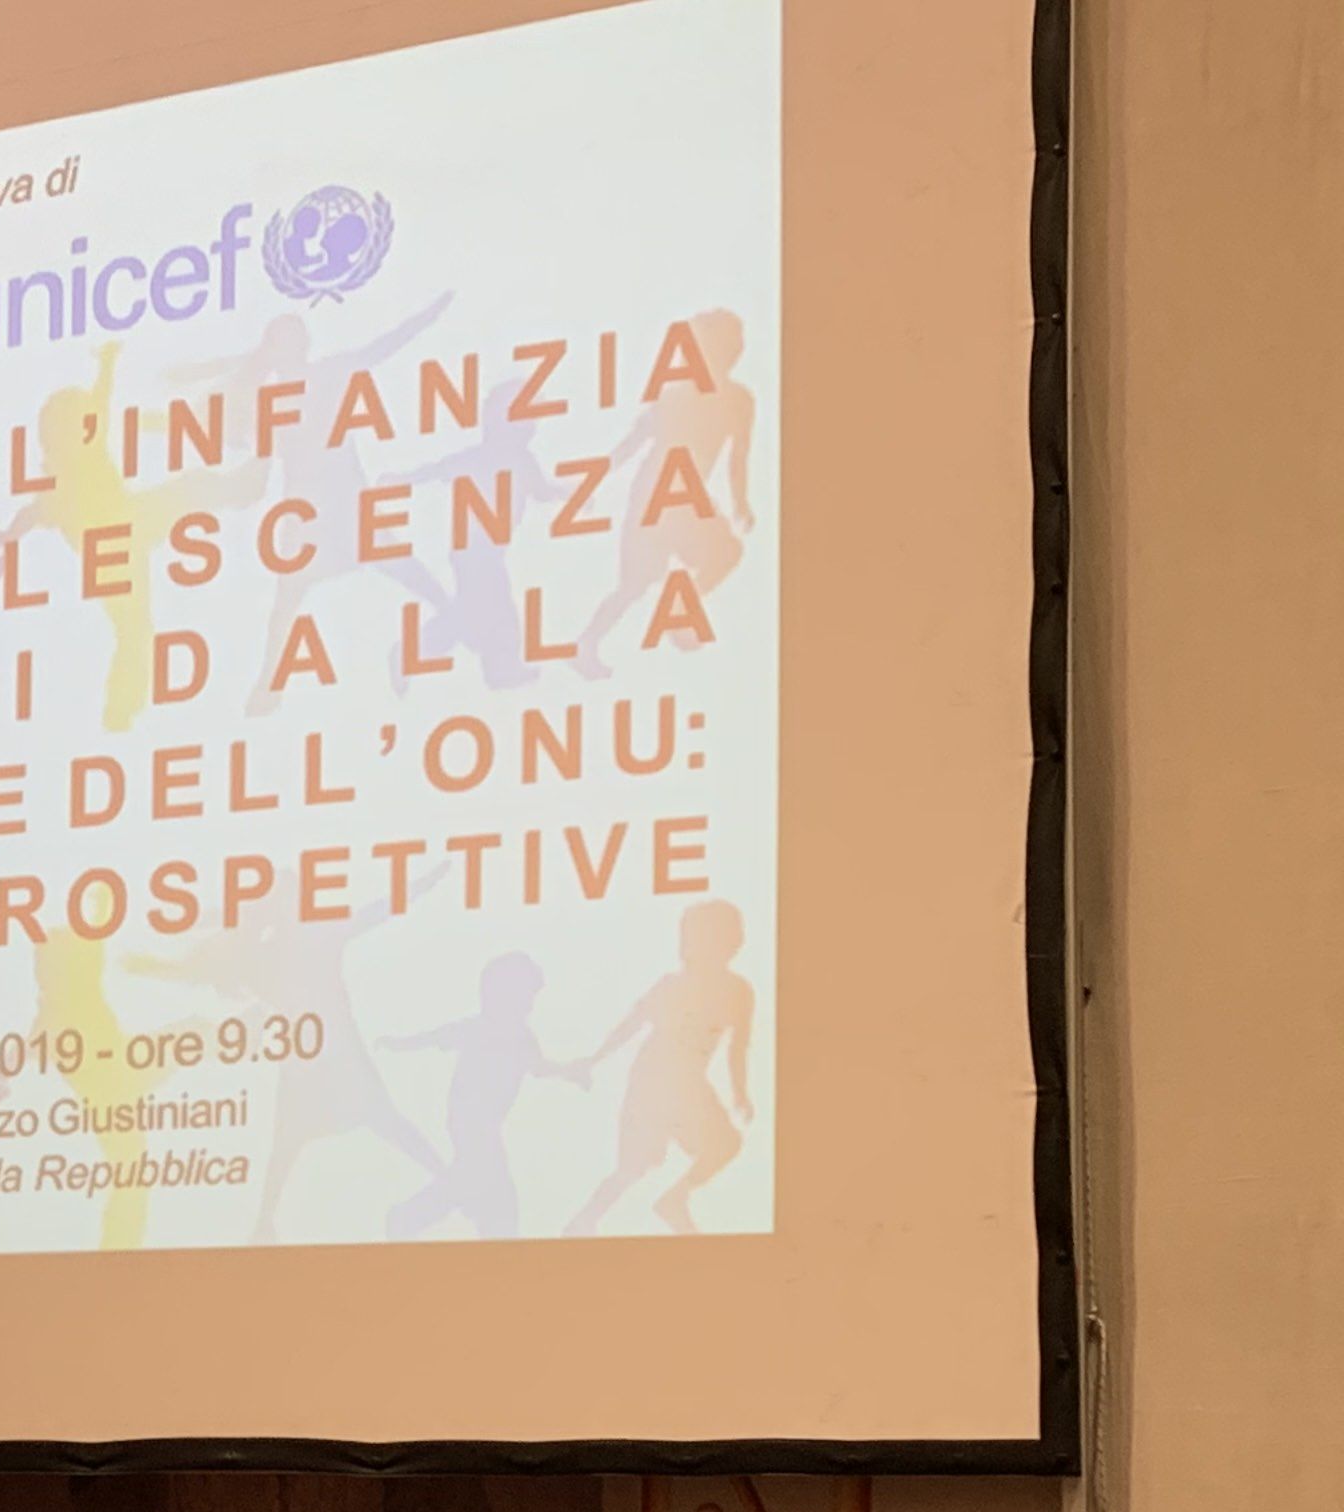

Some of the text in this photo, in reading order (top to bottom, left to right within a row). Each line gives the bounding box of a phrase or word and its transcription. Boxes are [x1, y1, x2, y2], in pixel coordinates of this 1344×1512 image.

[44, 155, 81, 198] di
[153, 569, 716, 705] DALLA
[68, 694, 707, 829] DELL'ONU:
[125, 1029, 205, 1070] ore
[217, 1012, 324, 1065] 9.30
[48, 1089, 249, 1135] Giustiniani
[34, 1147, 249, 1199] Repubblica
